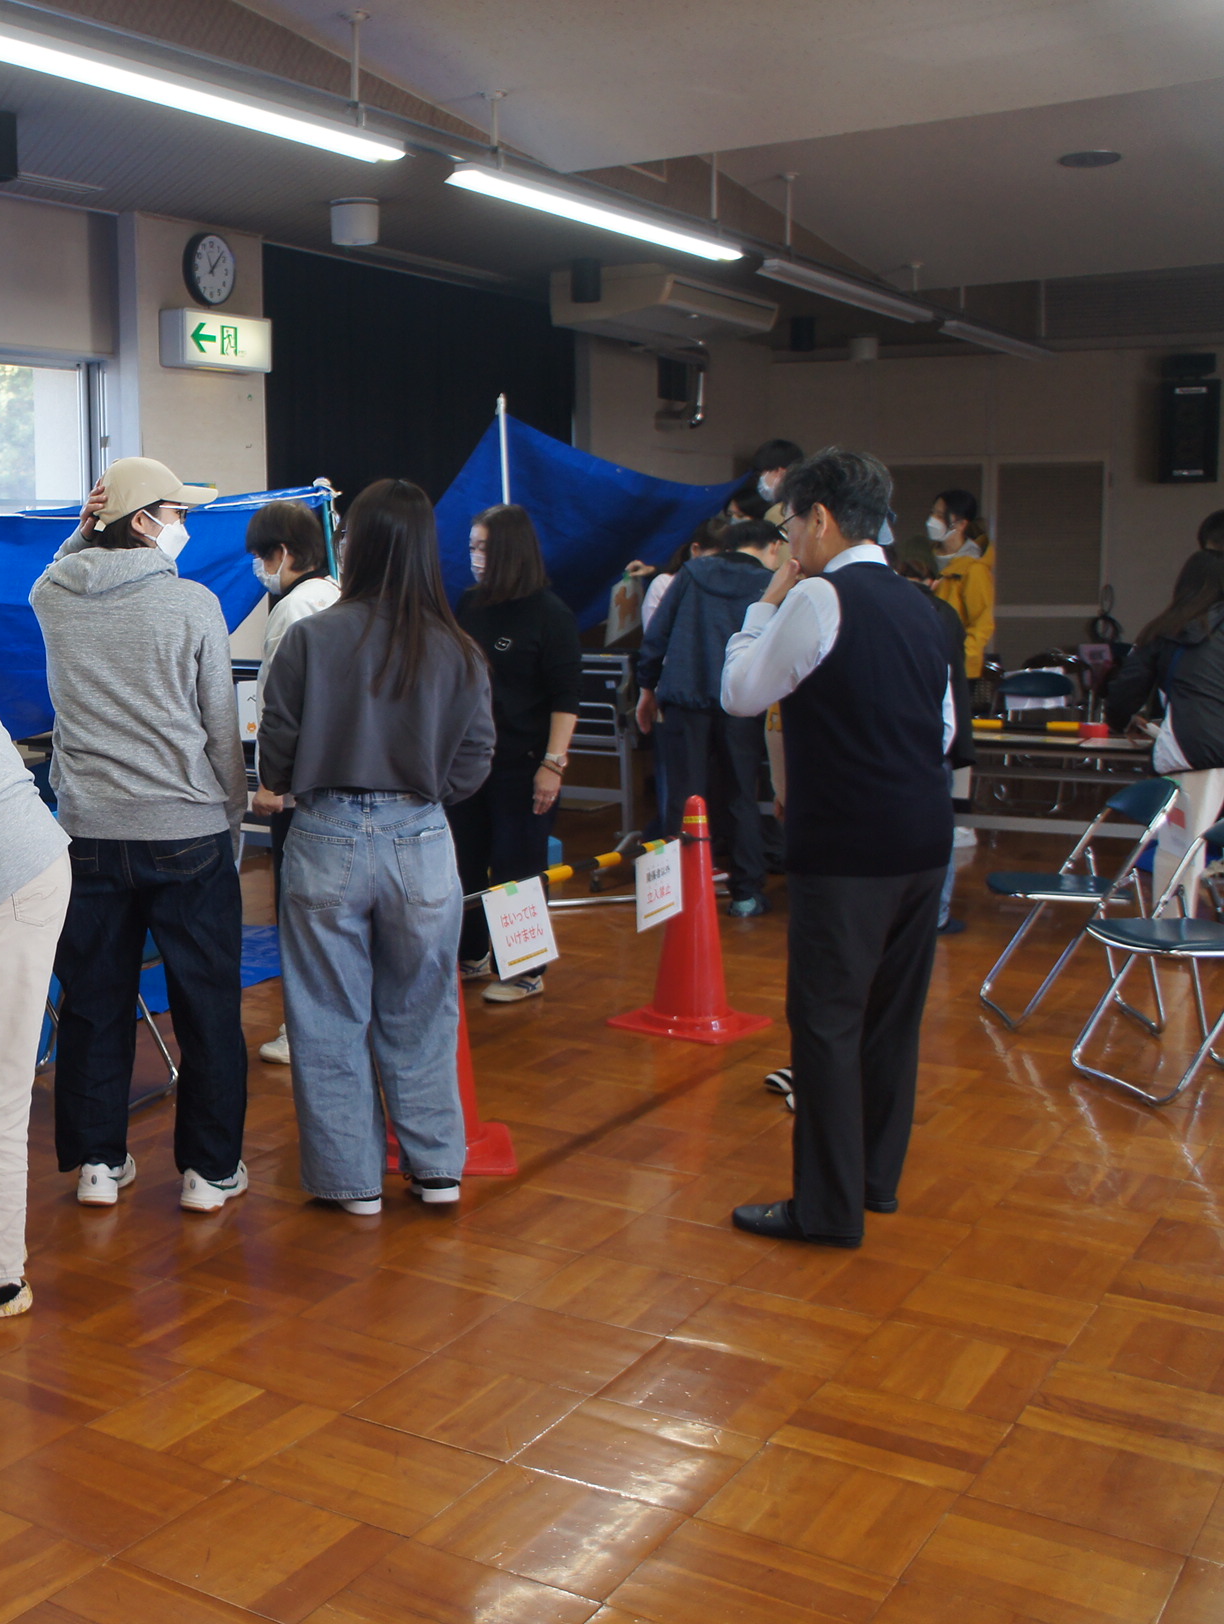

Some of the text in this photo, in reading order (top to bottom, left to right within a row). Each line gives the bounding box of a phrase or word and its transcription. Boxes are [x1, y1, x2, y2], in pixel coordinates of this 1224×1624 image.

[647, 885, 672, 904] 立入禁止
[500, 904, 537, 927] はいっては
[506, 923, 544, 948] いけません
